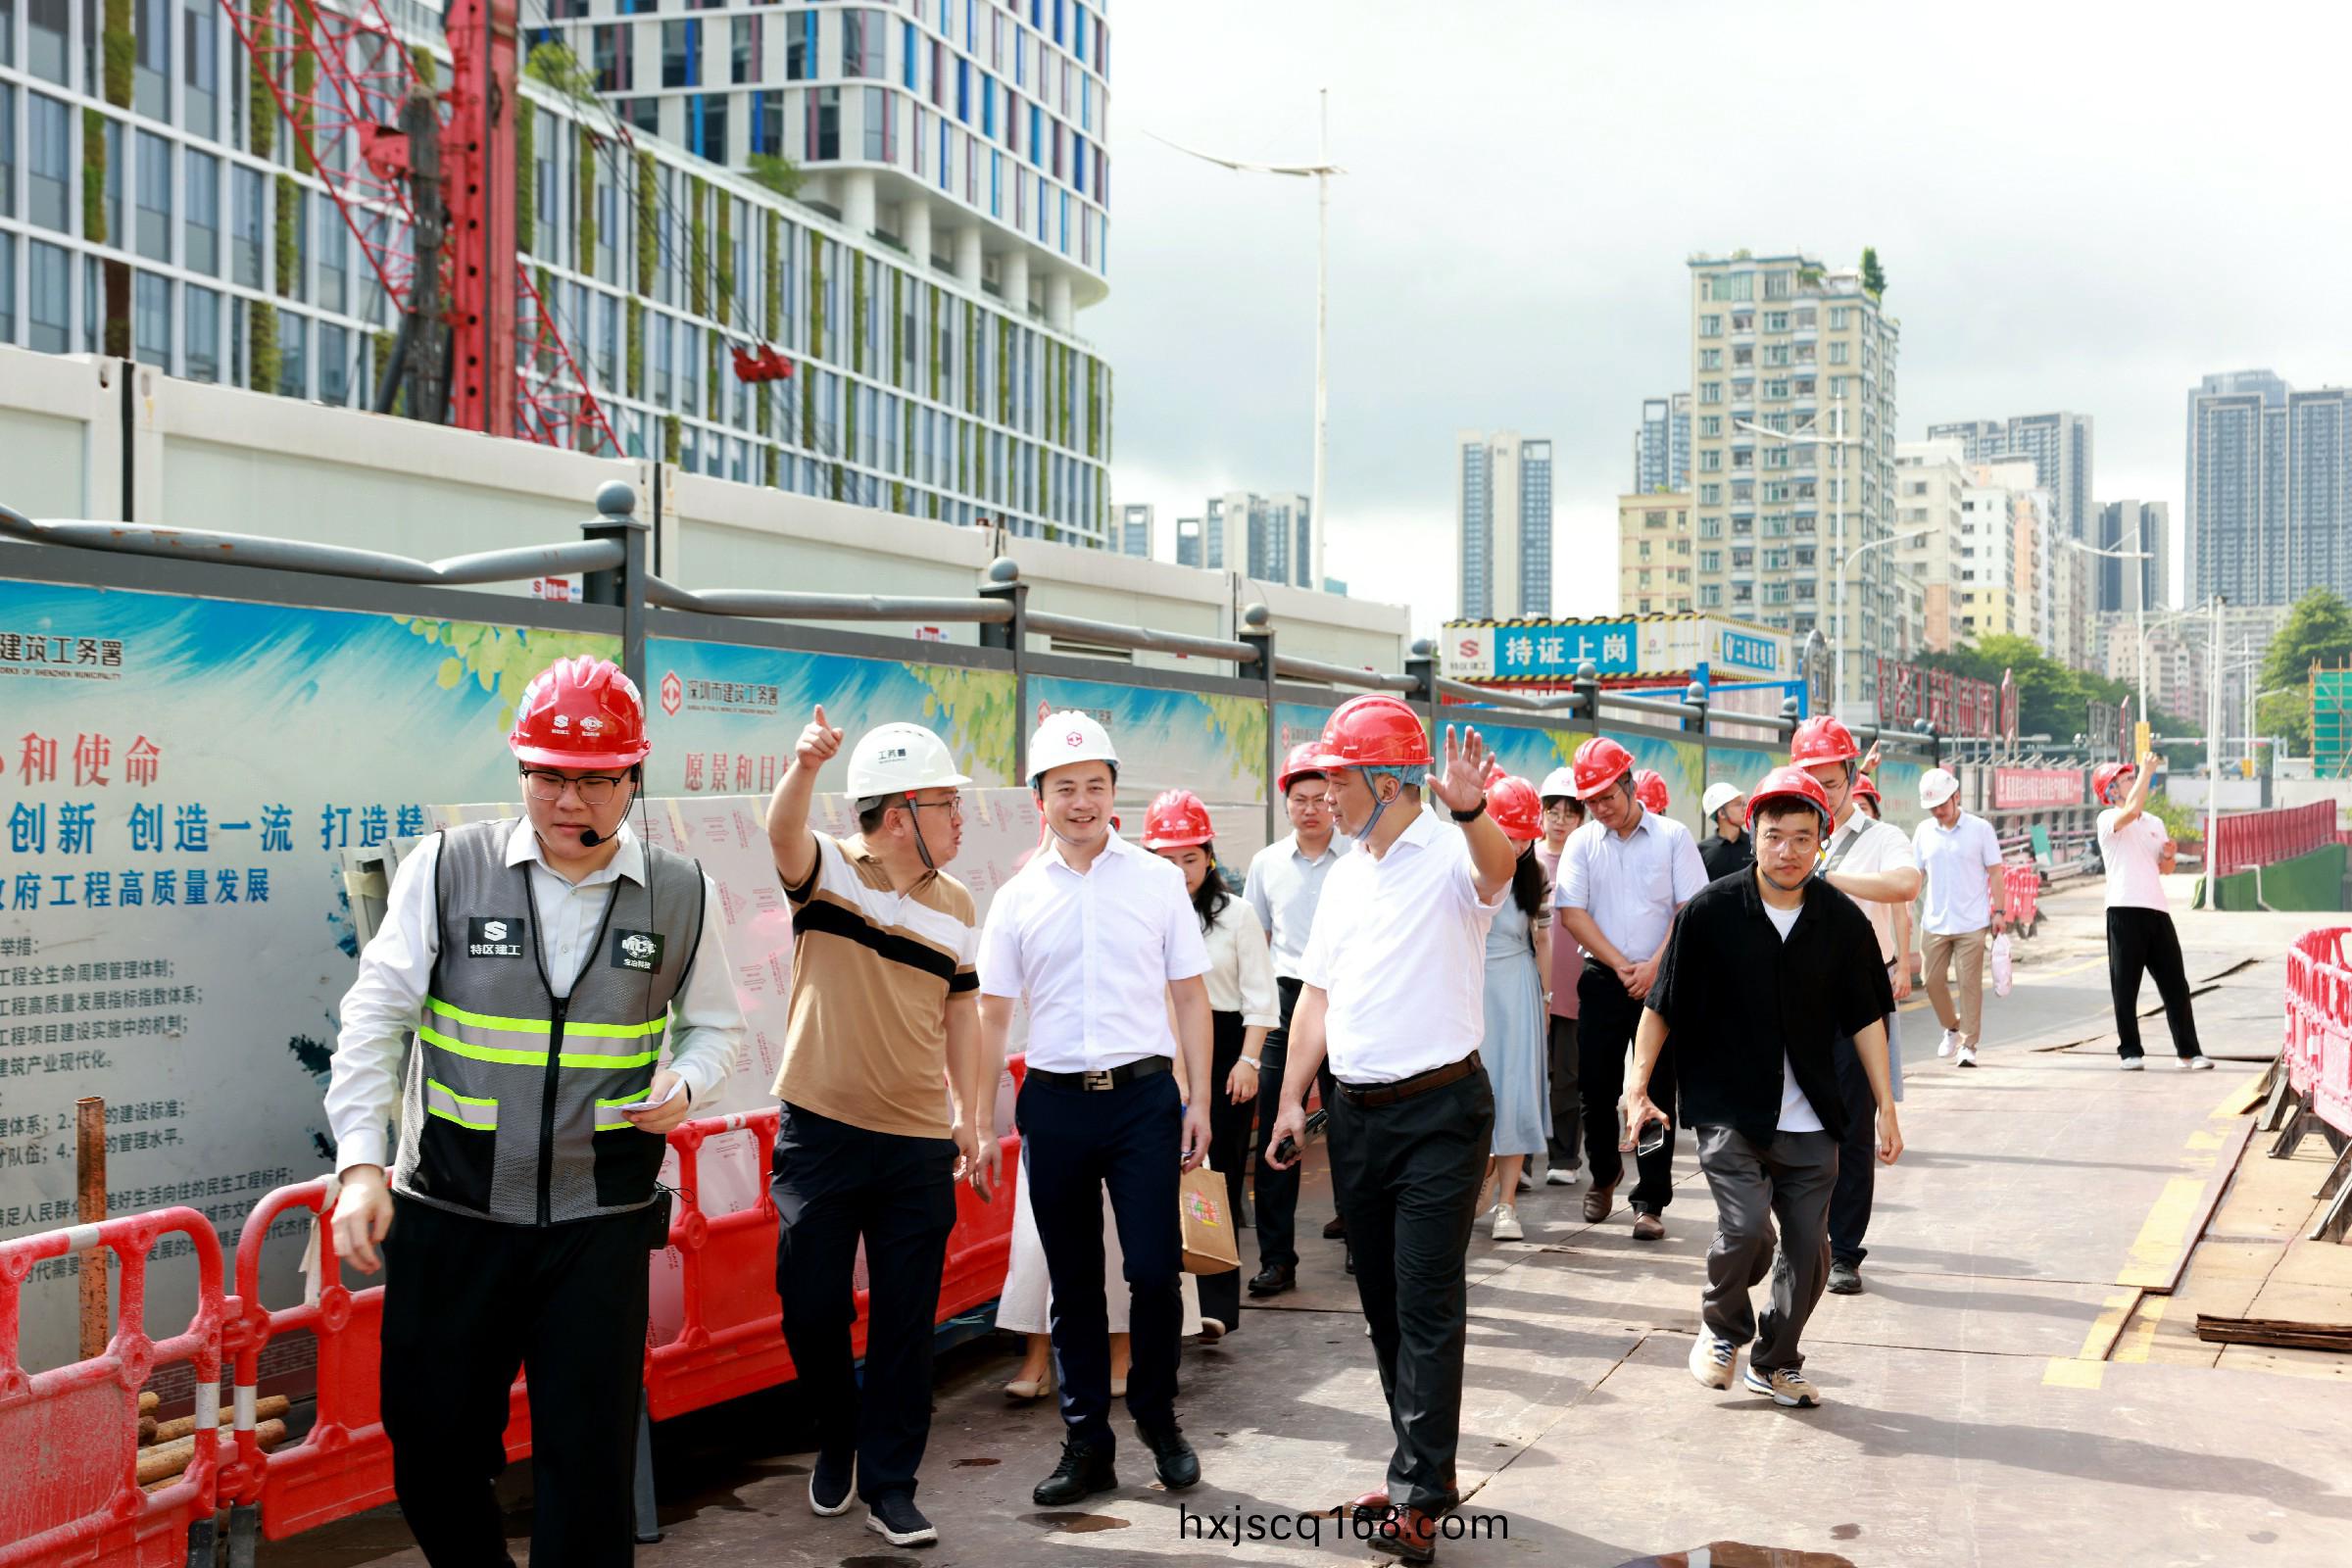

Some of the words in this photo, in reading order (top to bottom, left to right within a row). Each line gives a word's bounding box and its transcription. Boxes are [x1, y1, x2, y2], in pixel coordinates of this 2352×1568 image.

[0, 633, 122, 666] 建筑工务署
[1505, 633, 1628, 666] 持证上岗
[688, 679, 778, 706] 深圳市建筑工务署
[0, 732, 162, 787] 和使命
[7, 801, 96, 856] 创新
[126, 803, 294, 854] 创造一流
[469, 944, 521, 956] 特区建工
